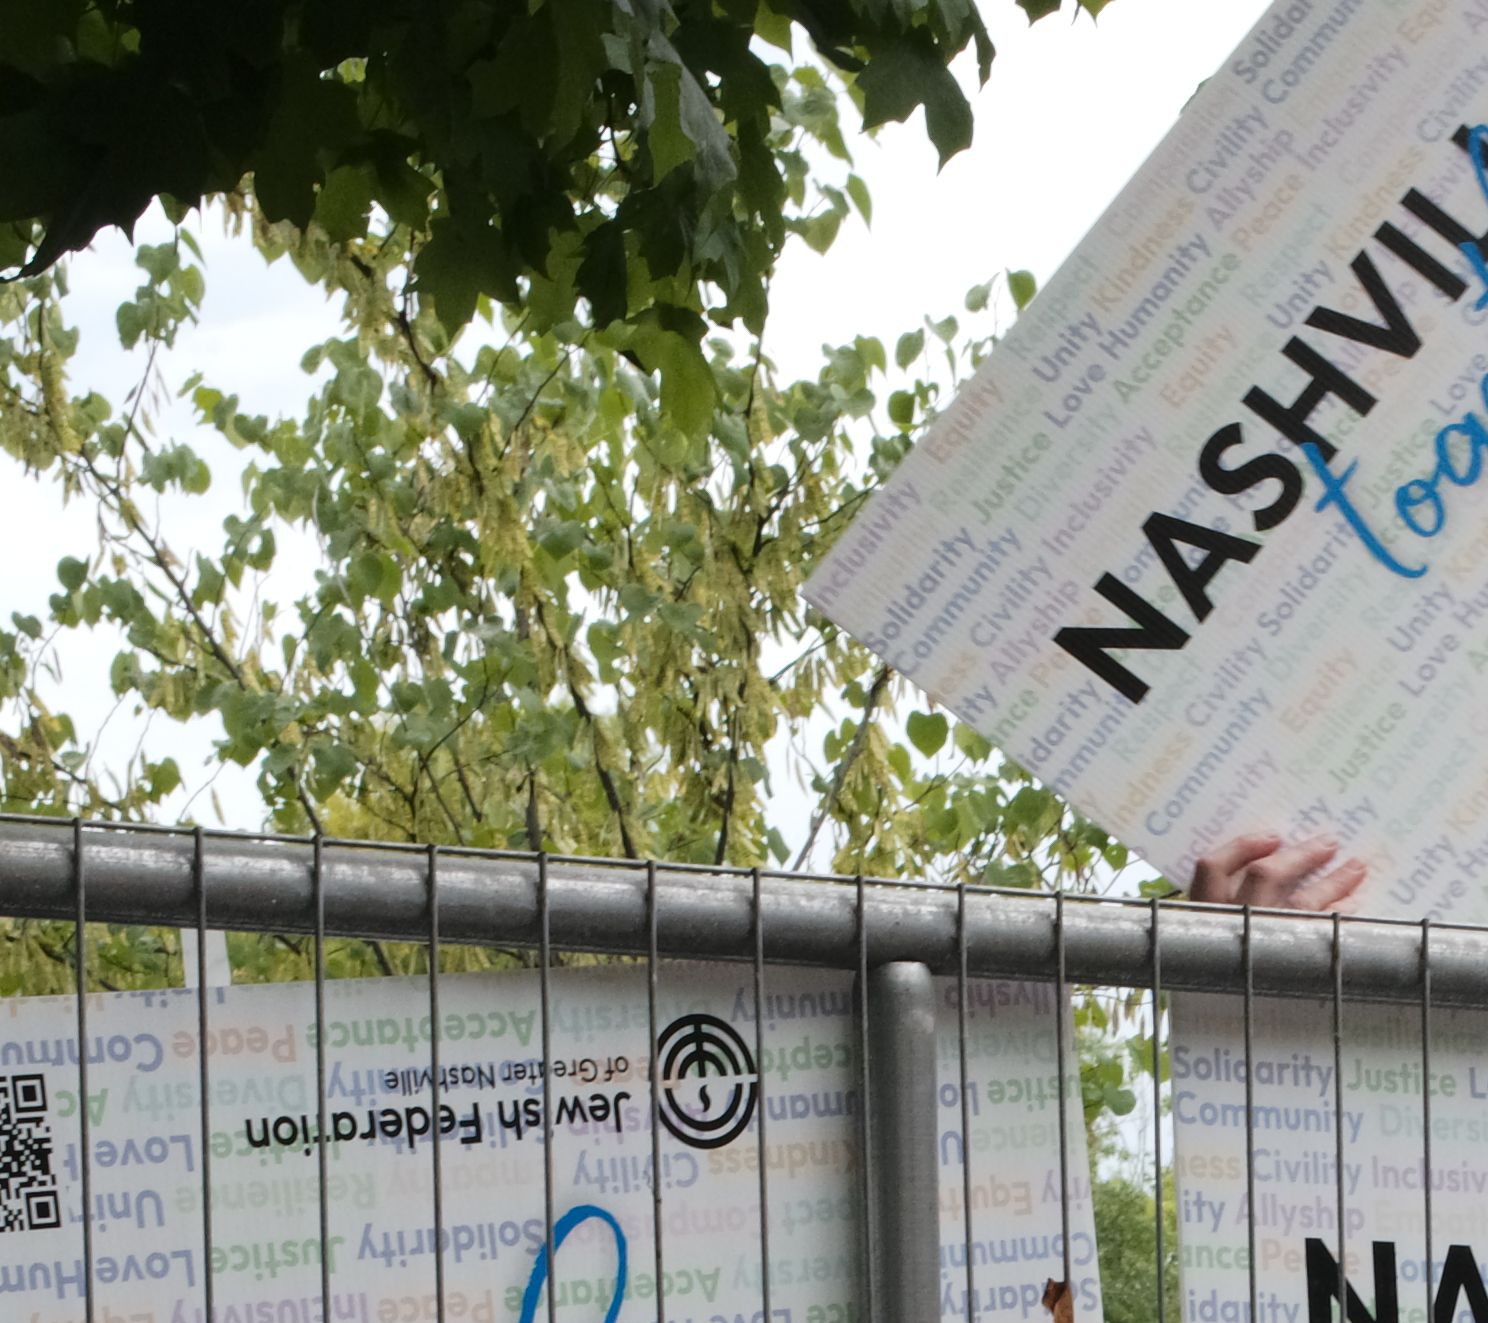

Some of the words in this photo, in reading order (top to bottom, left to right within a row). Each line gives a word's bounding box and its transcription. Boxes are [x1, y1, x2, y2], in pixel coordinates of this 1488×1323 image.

[1031, 311, 1104, 385] Unity
[1184, 103, 1270, 195] Civility
[1112, 250, 1243, 407] Acceptance
[1296, 44, 1410, 172] Inclusivity
[1045, 362, 1107, 430] Love
[1100, 232, 1214, 361] Humanity
[1205, 129, 1296, 232] Allyship
[865, 525, 979, 657] Solidarity
[894, 526, 1023, 676] Community
[383, 1060, 497, 1096] Nashville
[501, 1058, 600, 1088] Greater
[602, 1055, 630, 1085] of
[1173, 1046, 1334, 1096] Solidarity
[1345, 1059, 1457, 1100] Justice
[243, 1101, 483, 1156] Federation
[1175, 1090, 1364, 1143] Community
[96, 1250, 194, 1290] Love
[209, 1234, 346, 1280] Justice
[357, 1218, 544, 1270] Solidarity
